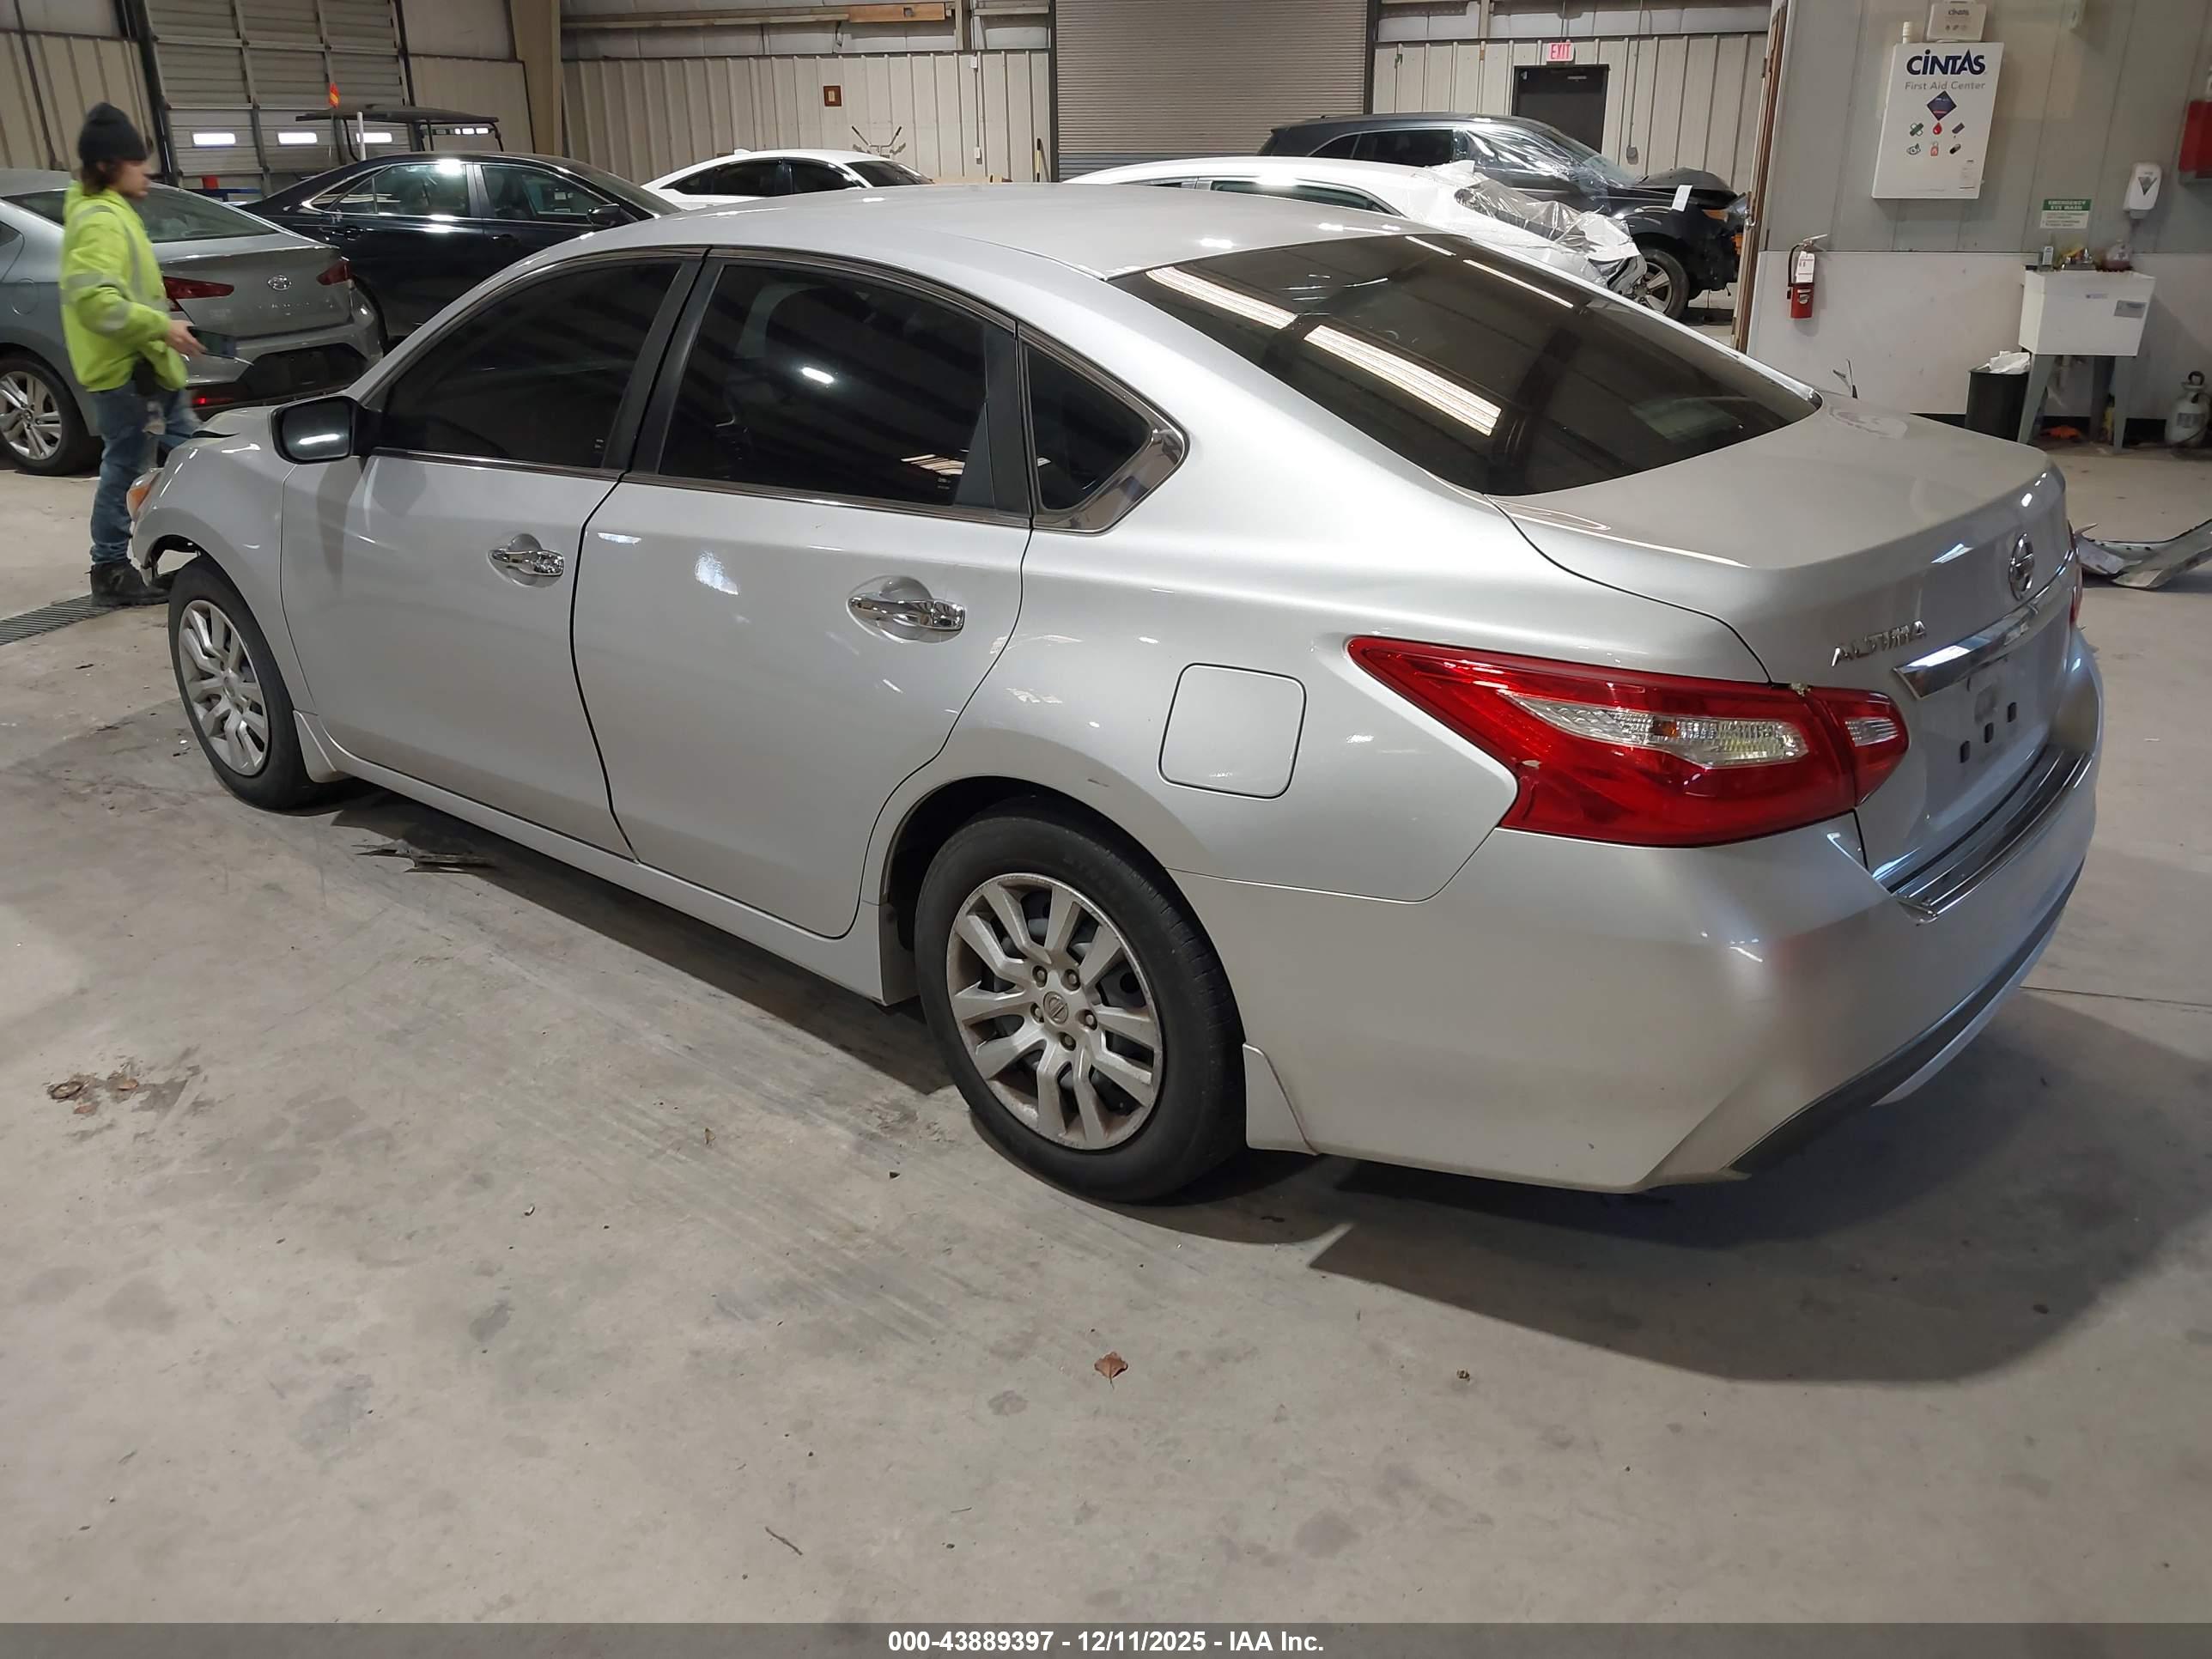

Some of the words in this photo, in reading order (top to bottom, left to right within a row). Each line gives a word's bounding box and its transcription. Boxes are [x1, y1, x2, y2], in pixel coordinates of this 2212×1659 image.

[1551, 44, 1571, 59] EXIT
[1905, 82, 1926, 90] First
[1929, 82, 1948, 90] Aid
[1951, 82, 1985, 90] Center
[1831, 620, 1926, 667] ALTIMA
